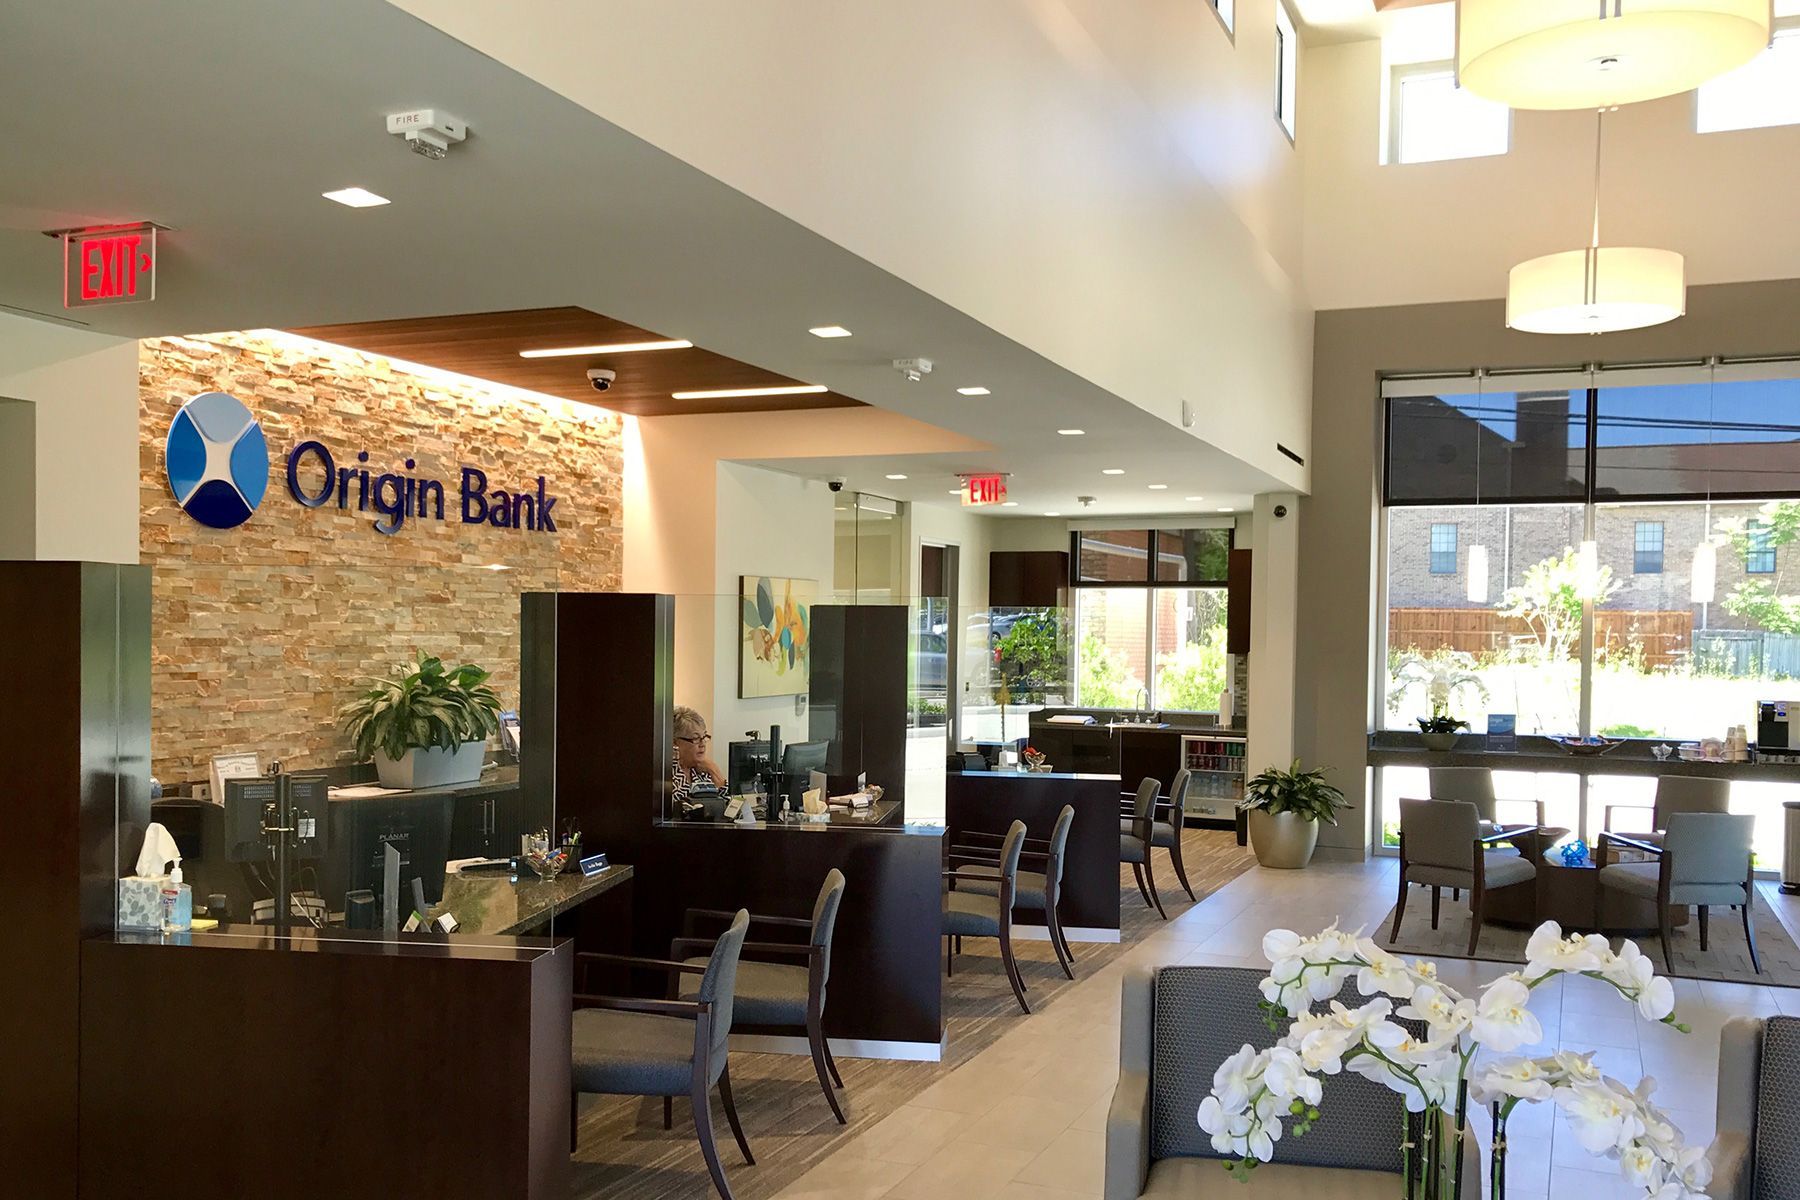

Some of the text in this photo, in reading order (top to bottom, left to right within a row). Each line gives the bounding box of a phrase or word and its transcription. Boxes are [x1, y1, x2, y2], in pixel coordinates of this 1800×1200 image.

[396, 114, 420, 125] FIRE
[81, 235, 142, 300] EXIT
[287, 440, 557, 535] Origin Bank
[970, 477, 999, 503] EXIT
